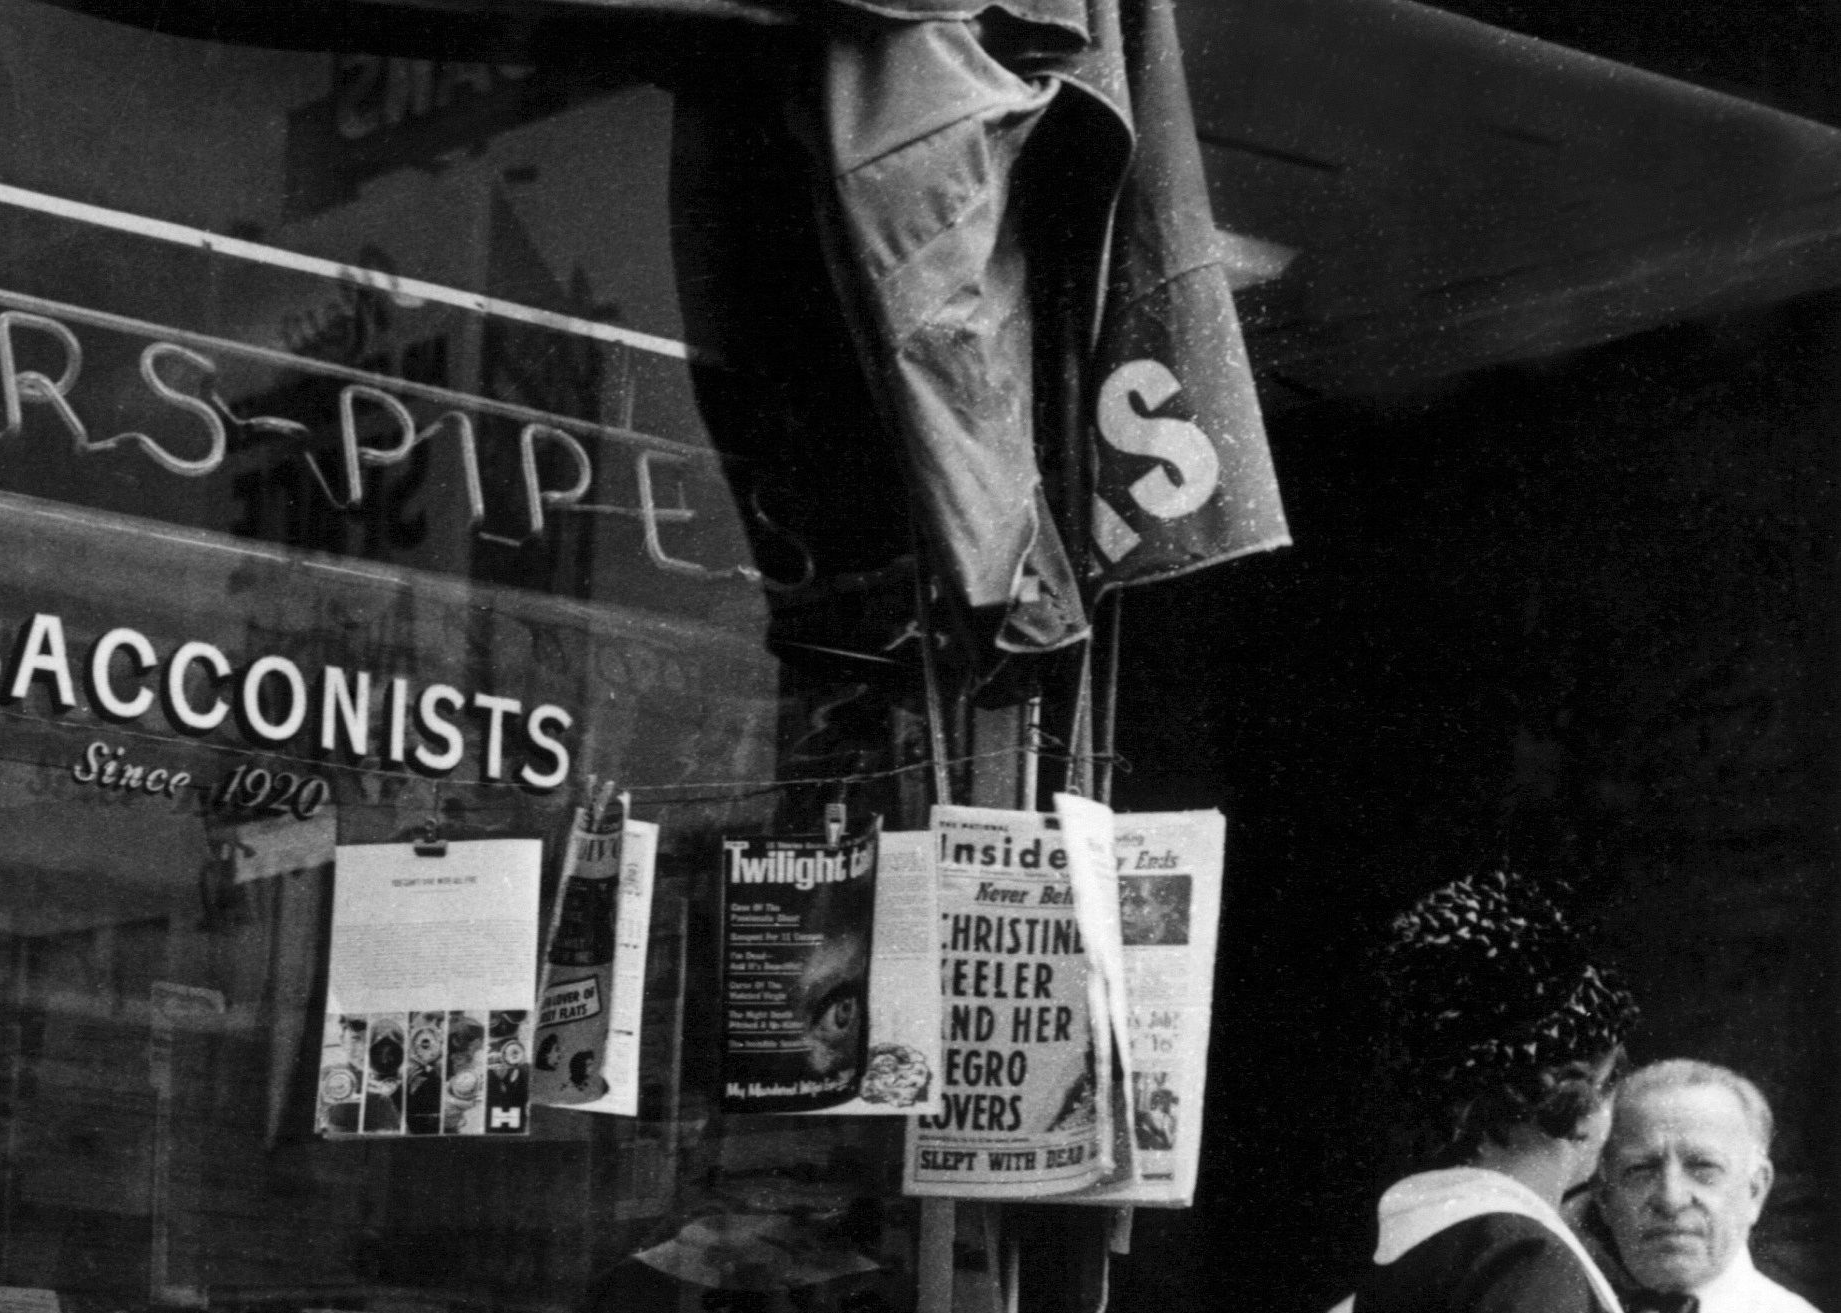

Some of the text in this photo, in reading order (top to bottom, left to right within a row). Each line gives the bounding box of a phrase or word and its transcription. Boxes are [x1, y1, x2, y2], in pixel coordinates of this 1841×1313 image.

[1096, 358, 1220, 519] S
[70, 739, 335, 822] Since 1920
[726, 839, 848, 890] Twilight
[1012, 1006, 1073, 1044] HER
[919, 1146, 1038, 1172] SLEPT WITH
